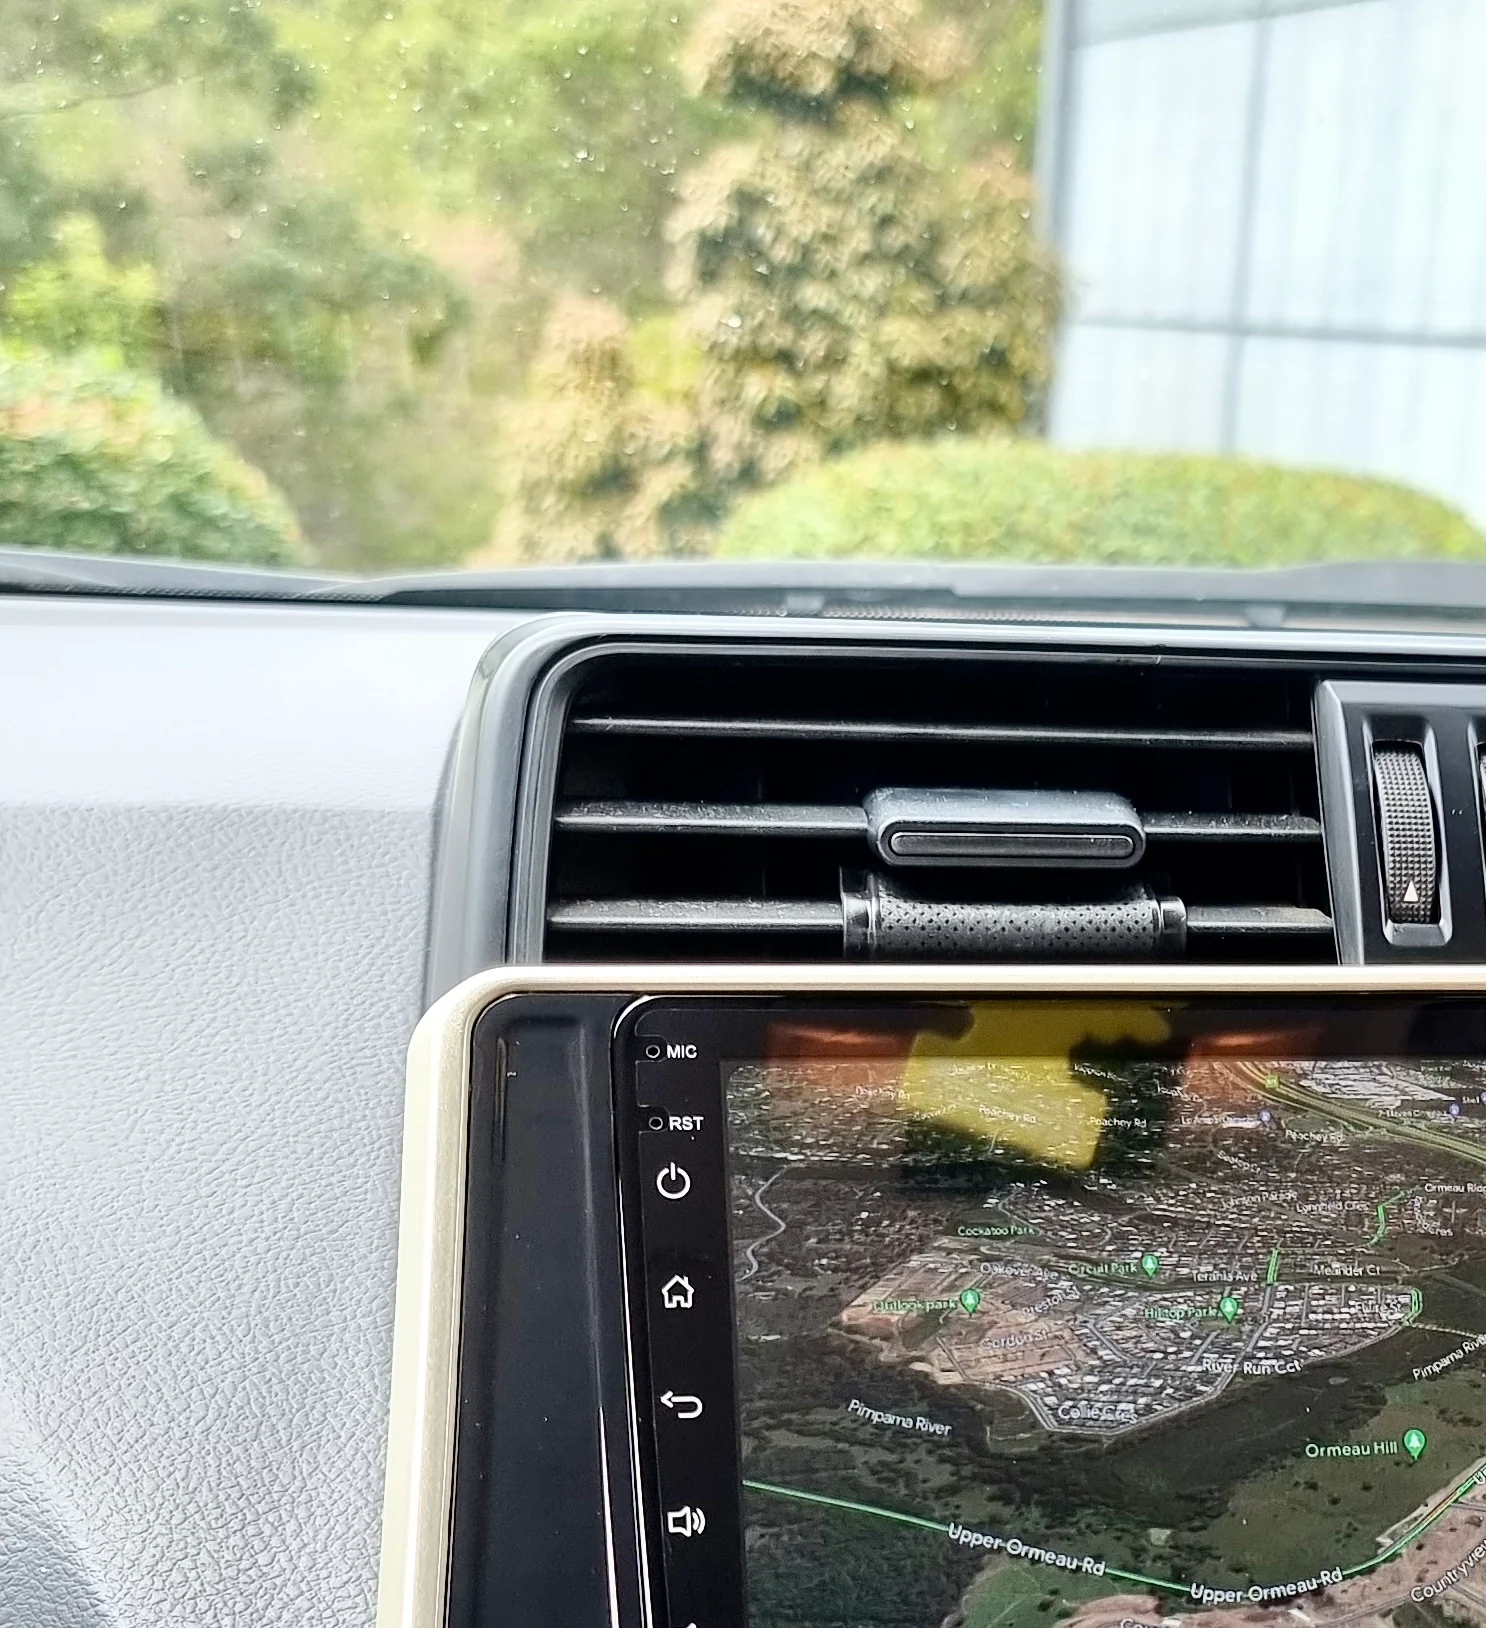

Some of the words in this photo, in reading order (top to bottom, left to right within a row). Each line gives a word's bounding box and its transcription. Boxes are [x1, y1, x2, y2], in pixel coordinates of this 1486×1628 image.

[666, 1044, 698, 1059] MIC
[668, 1115, 705, 1131] RST
[1133, 1118, 1147, 1128] Rd
[1424, 1183, 1465, 1194] Ormeau
[1111, 1263, 1138, 1275] Park
[1233, 1269, 1259, 1282] Ave
[1186, 1305, 1214, 1318] Park
[1202, 1360, 1241, 1374] River
[1242, 1361, 1272, 1375] Run
[1273, 1360, 1302, 1374] Cct
[1412, 1349, 1464, 1381] Pimpama
[848, 1399, 914, 1430] Pimpama
[914, 1414, 953, 1437] River
[1305, 1442, 1371, 1459] Ormeau
[1372, 1441, 1398, 1456] Hill
[947, 1521, 1002, 1550] Upper
[1005, 1536, 1078, 1570] Ormeau
[1081, 1558, 1106, 1577] Rd
[1190, 1583, 1244, 1604] Upper
[1247, 1577, 1318, 1603] Ormeau
[1318, 1566, 1344, 1584] Rd
